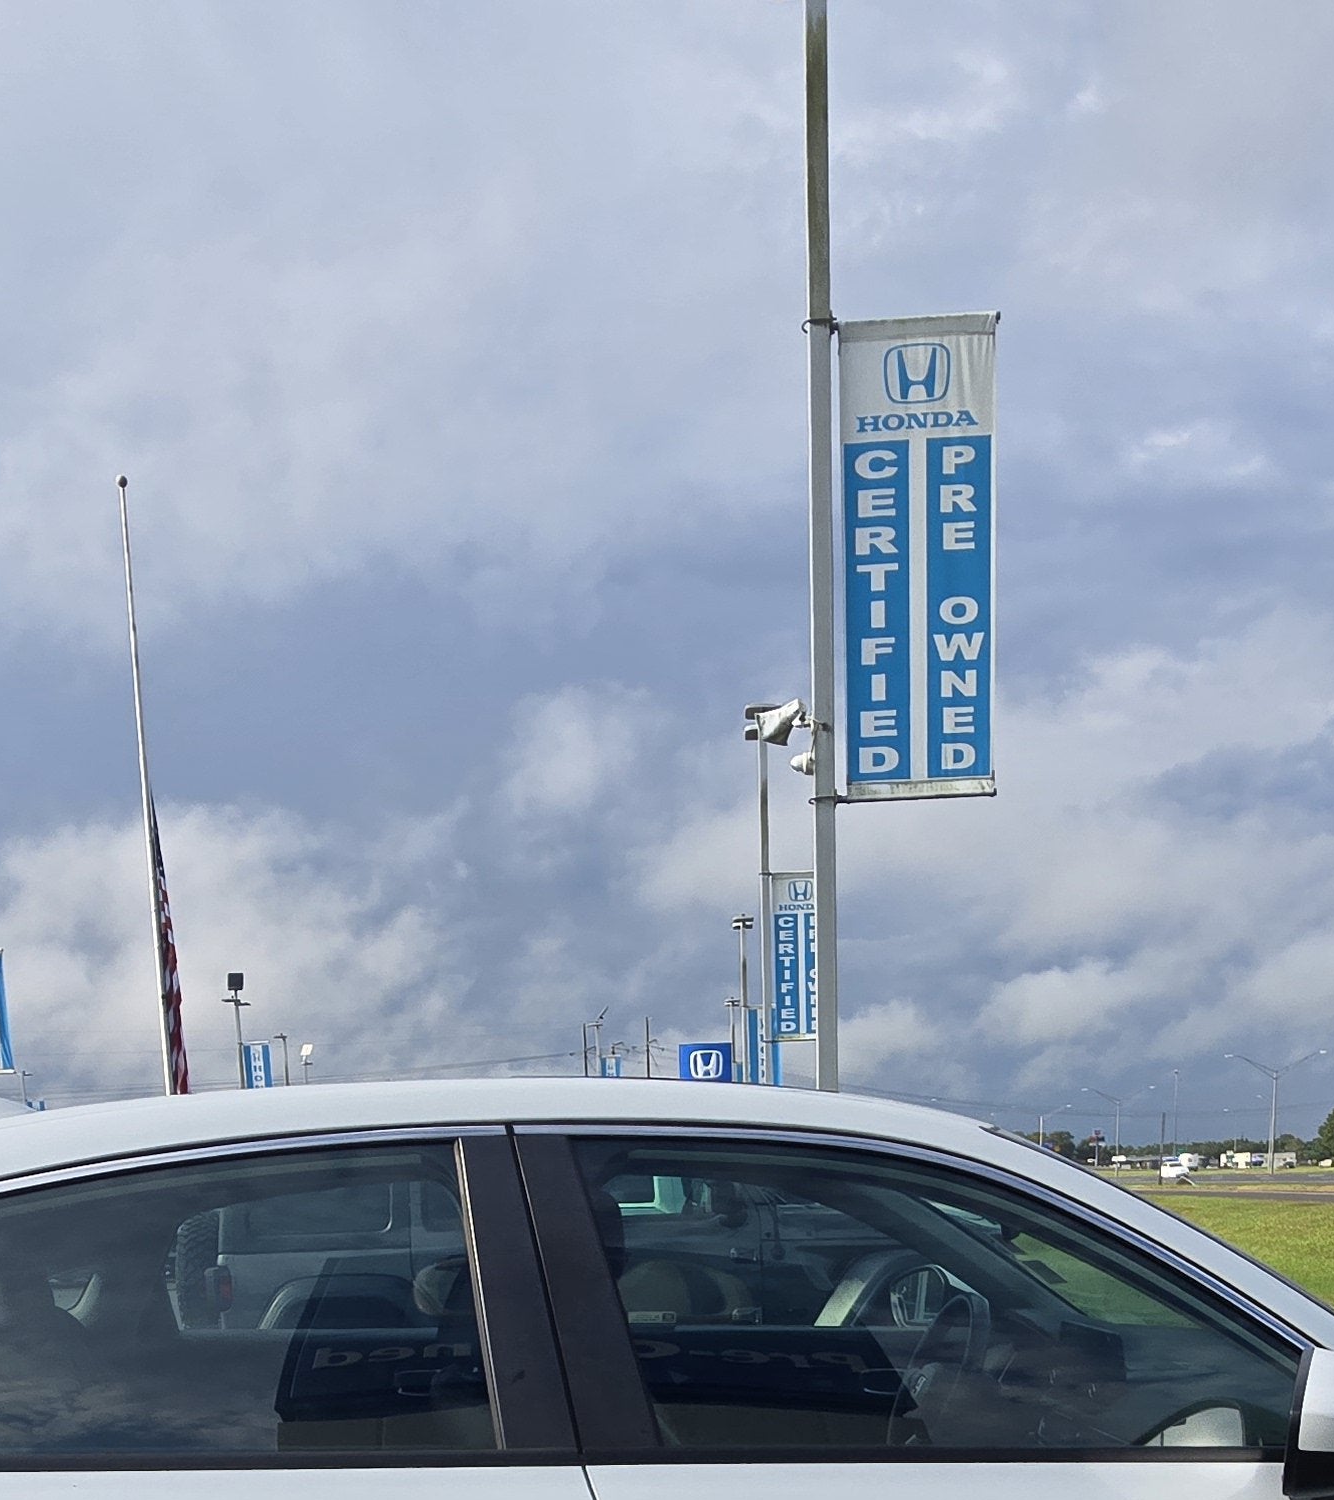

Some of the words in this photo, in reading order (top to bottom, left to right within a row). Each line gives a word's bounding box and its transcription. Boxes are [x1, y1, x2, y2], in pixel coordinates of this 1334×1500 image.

[856, 409, 979, 433] HONDA
[941, 445, 975, 550] PRE
[854, 449, 900, 774] CERTIFIED
[932, 596, 984, 770] OWNED
[778, 903, 815, 911] HOND
[778, 916, 797, 1032] CERTIFIED
